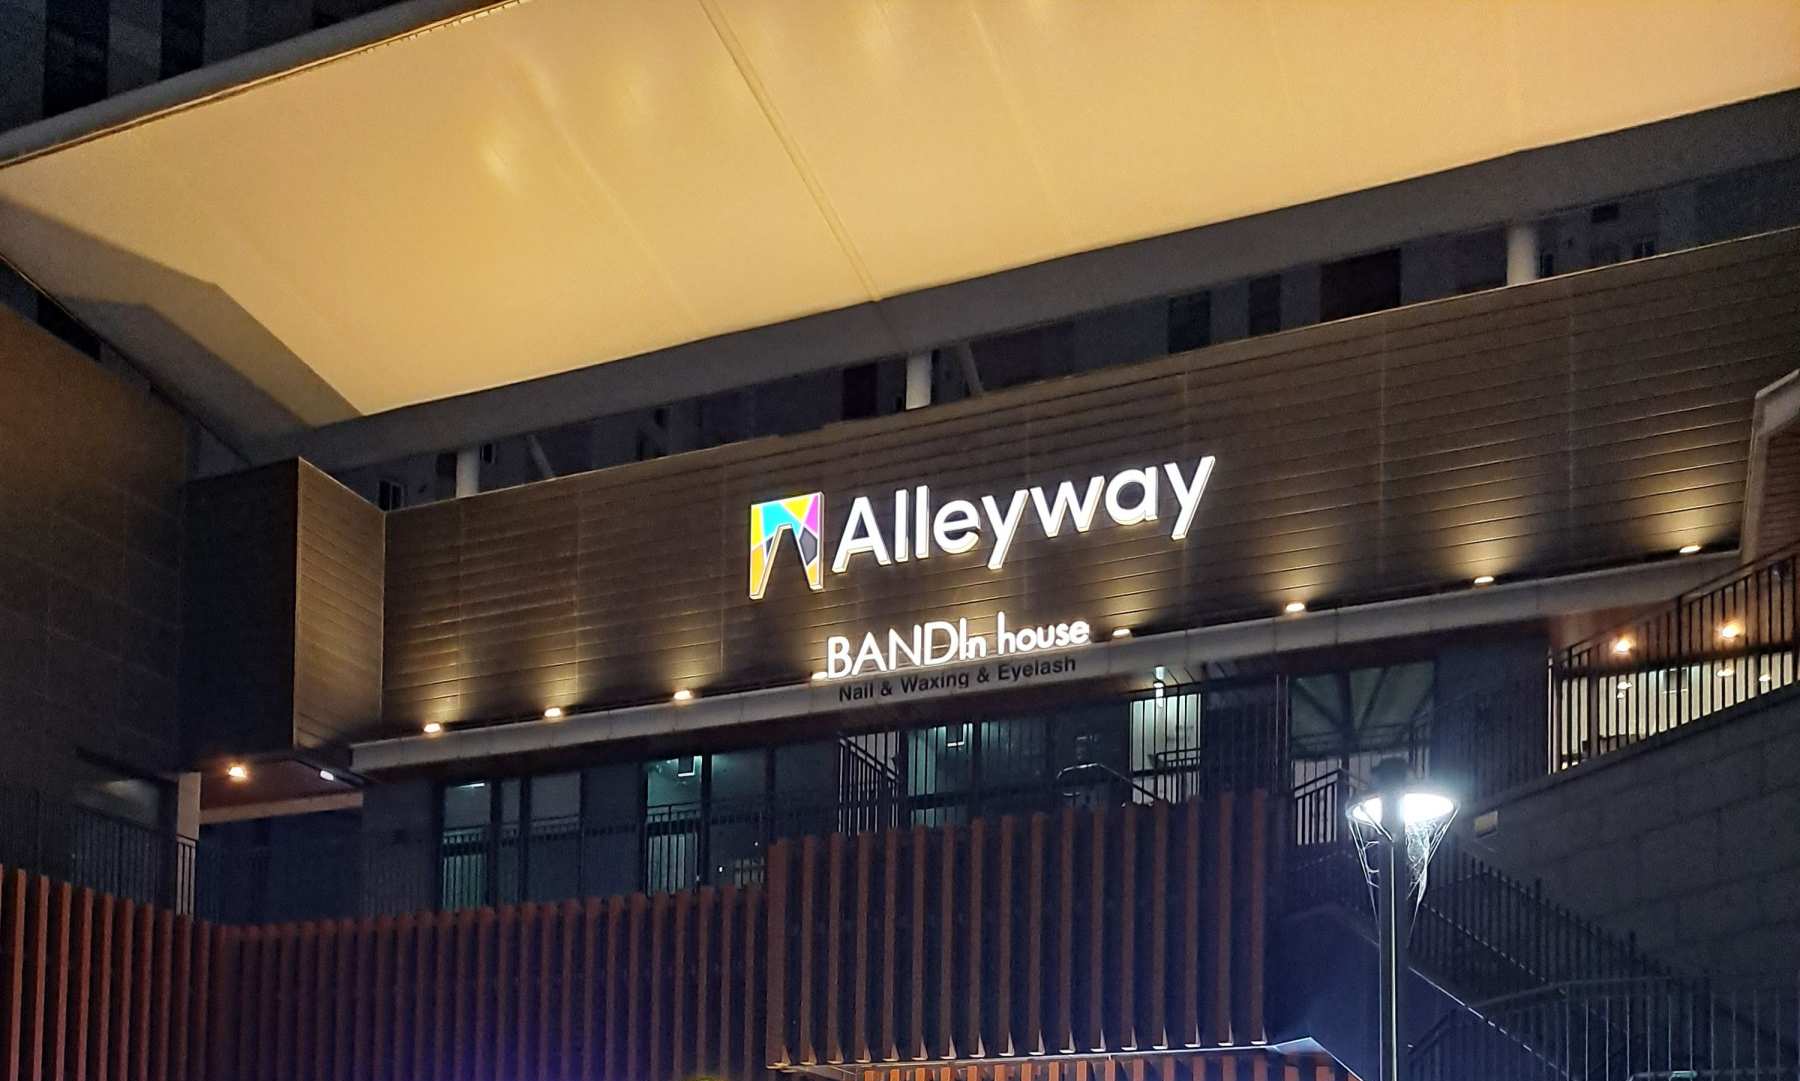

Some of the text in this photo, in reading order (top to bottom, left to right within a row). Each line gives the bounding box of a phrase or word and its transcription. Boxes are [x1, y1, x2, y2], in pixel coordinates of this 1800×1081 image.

[832, 455, 1216, 573] Alleyway
[997, 611, 1090, 654] house
[839, 656, 1077, 703] Nail & Waxing & Eyelash
